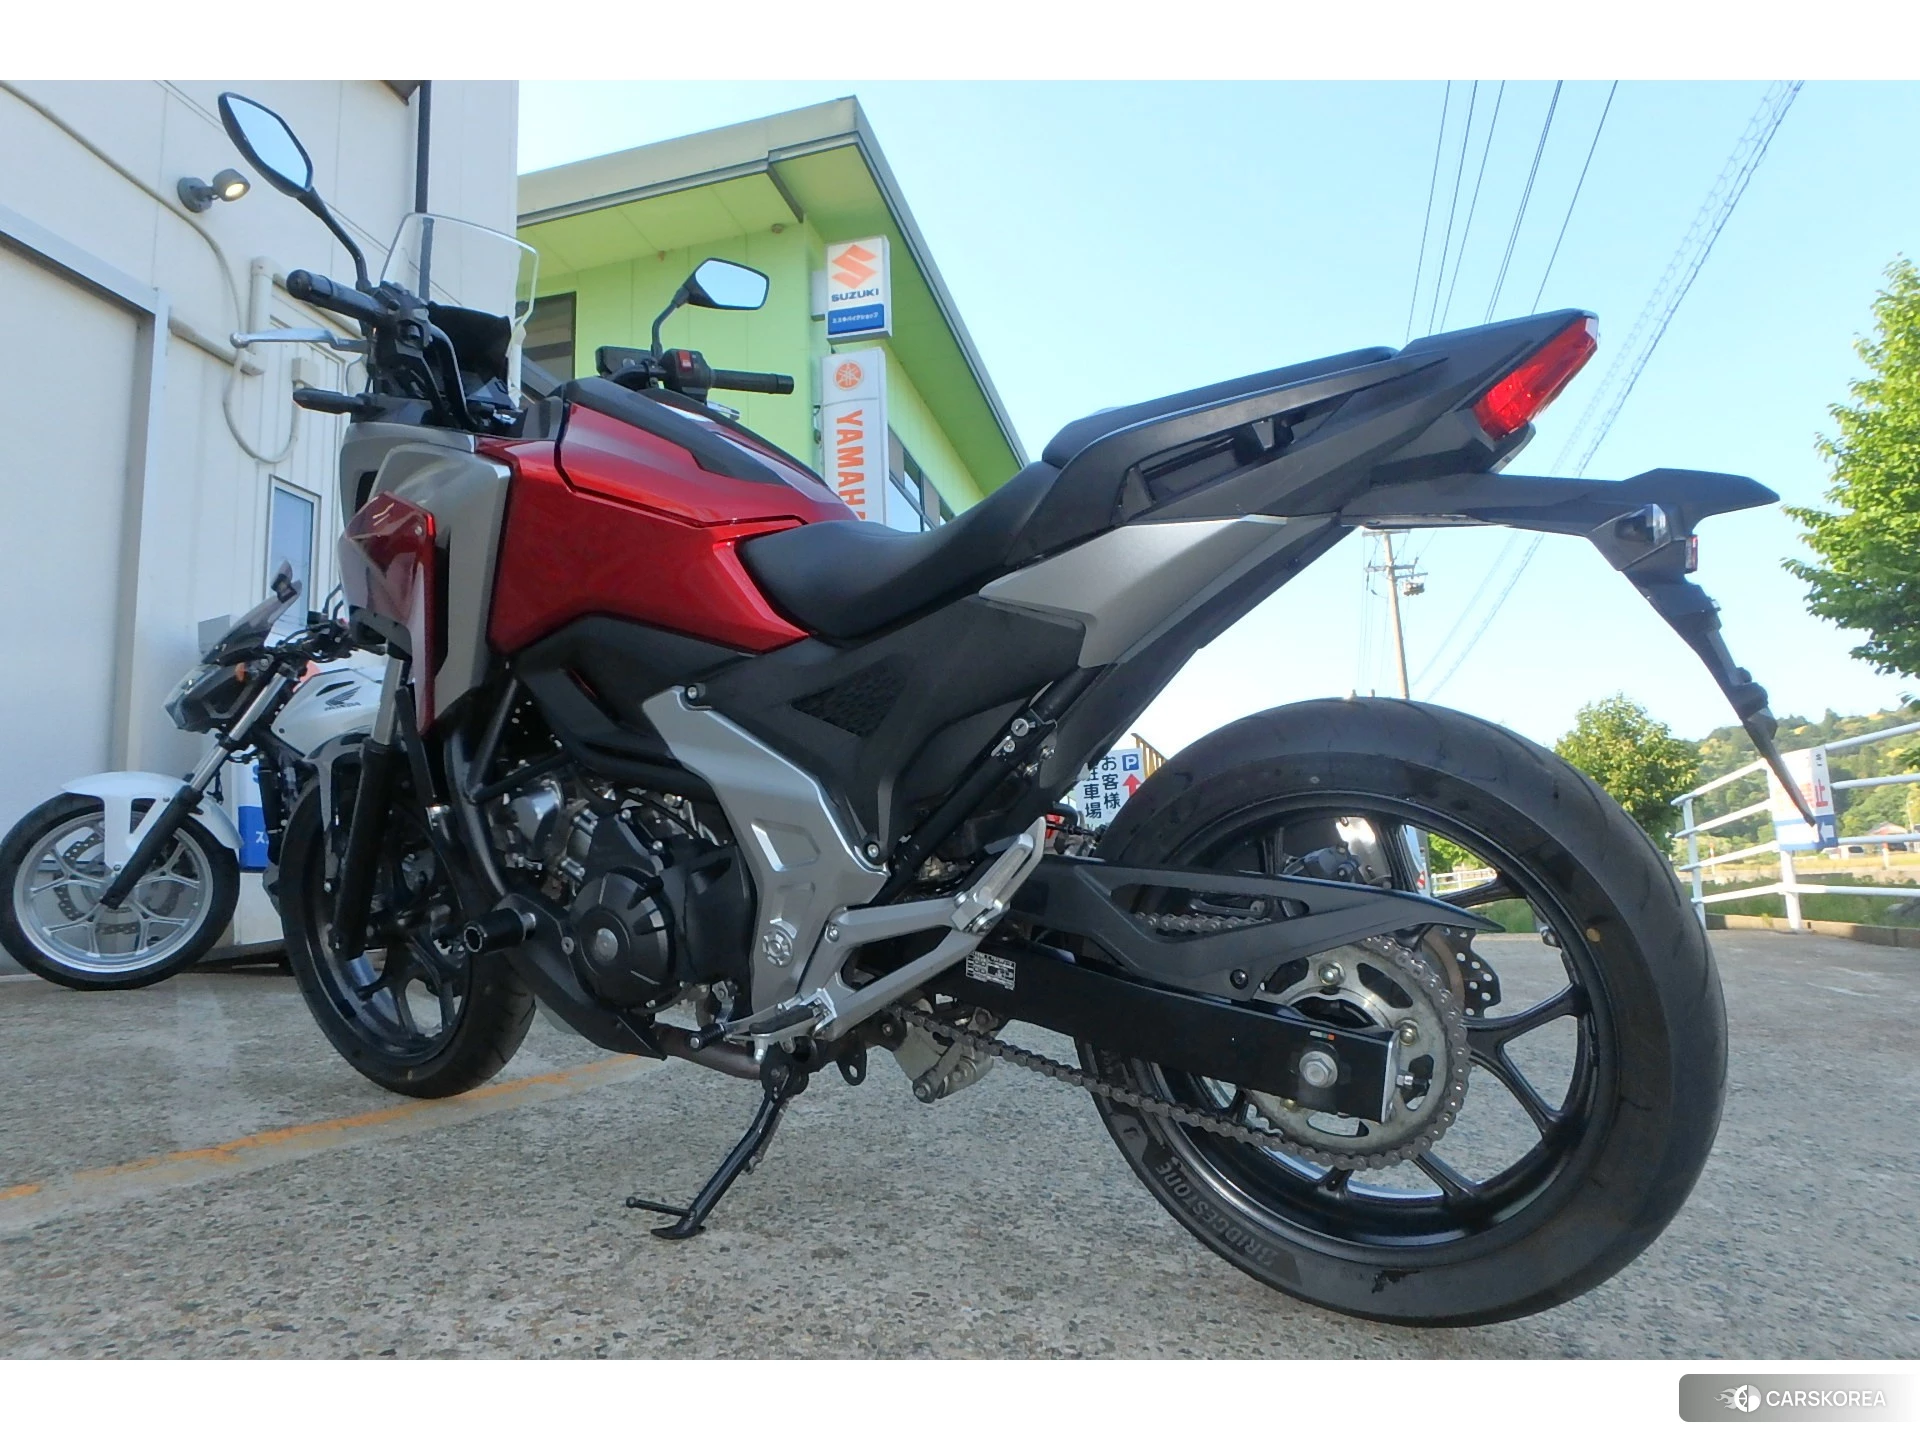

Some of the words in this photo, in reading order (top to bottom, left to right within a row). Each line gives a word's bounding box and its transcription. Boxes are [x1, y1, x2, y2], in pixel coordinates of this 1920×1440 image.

[831, 288, 879, 302] SUZUKI
[836, 409, 866, 520] YAMAH
[1101, 756, 1121, 810] お客様
